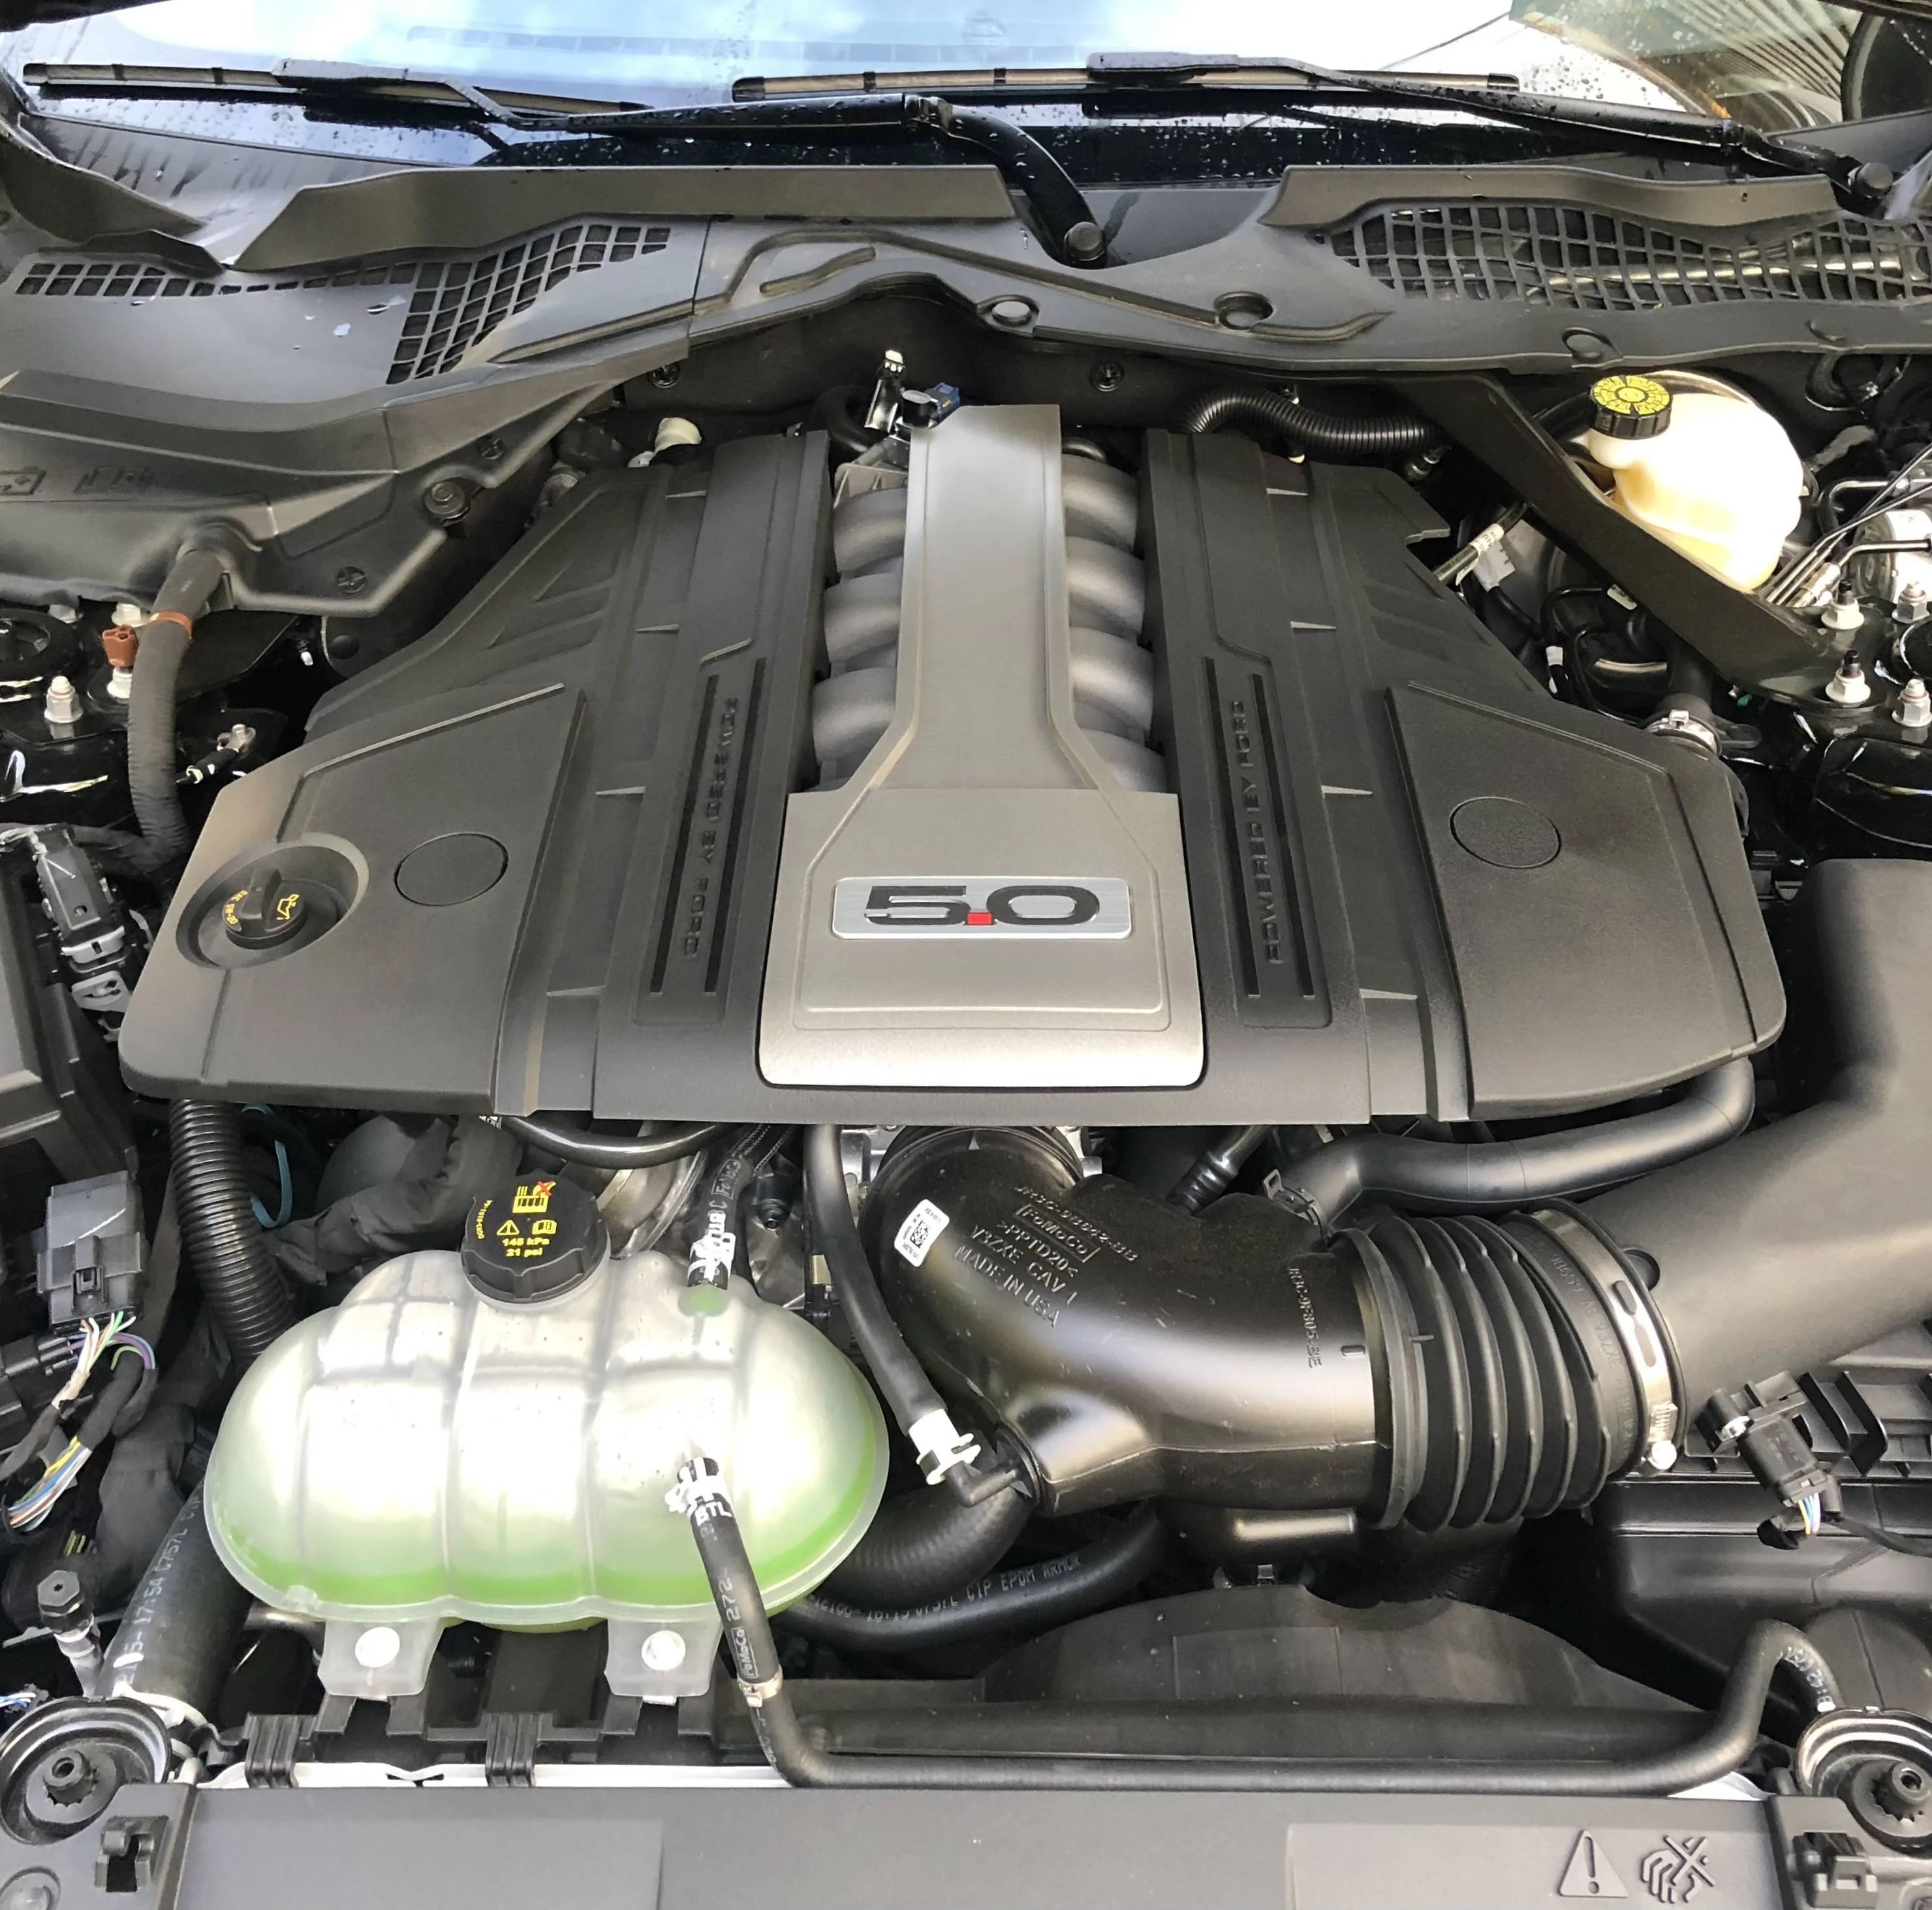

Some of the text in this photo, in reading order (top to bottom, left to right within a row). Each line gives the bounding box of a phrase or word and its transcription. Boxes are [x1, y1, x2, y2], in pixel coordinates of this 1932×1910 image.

[1231, 700, 1284, 964] POWERED BY FORD
[864, 885, 1100, 926] 5.0
[502, 1237, 550, 1247] 145 kPa
[1021, 1207, 1090, 1255] FoMoCo
[506, 1247, 543, 1258] 21 psi
[954, 1244, 1005, 1283] MADE
[1003, 1273, 1025, 1297] IN
[1025, 1290, 1061, 1327] USA
[1027, 1263, 1067, 1294] CAV
[695, 1500, 734, 1527] BTL
